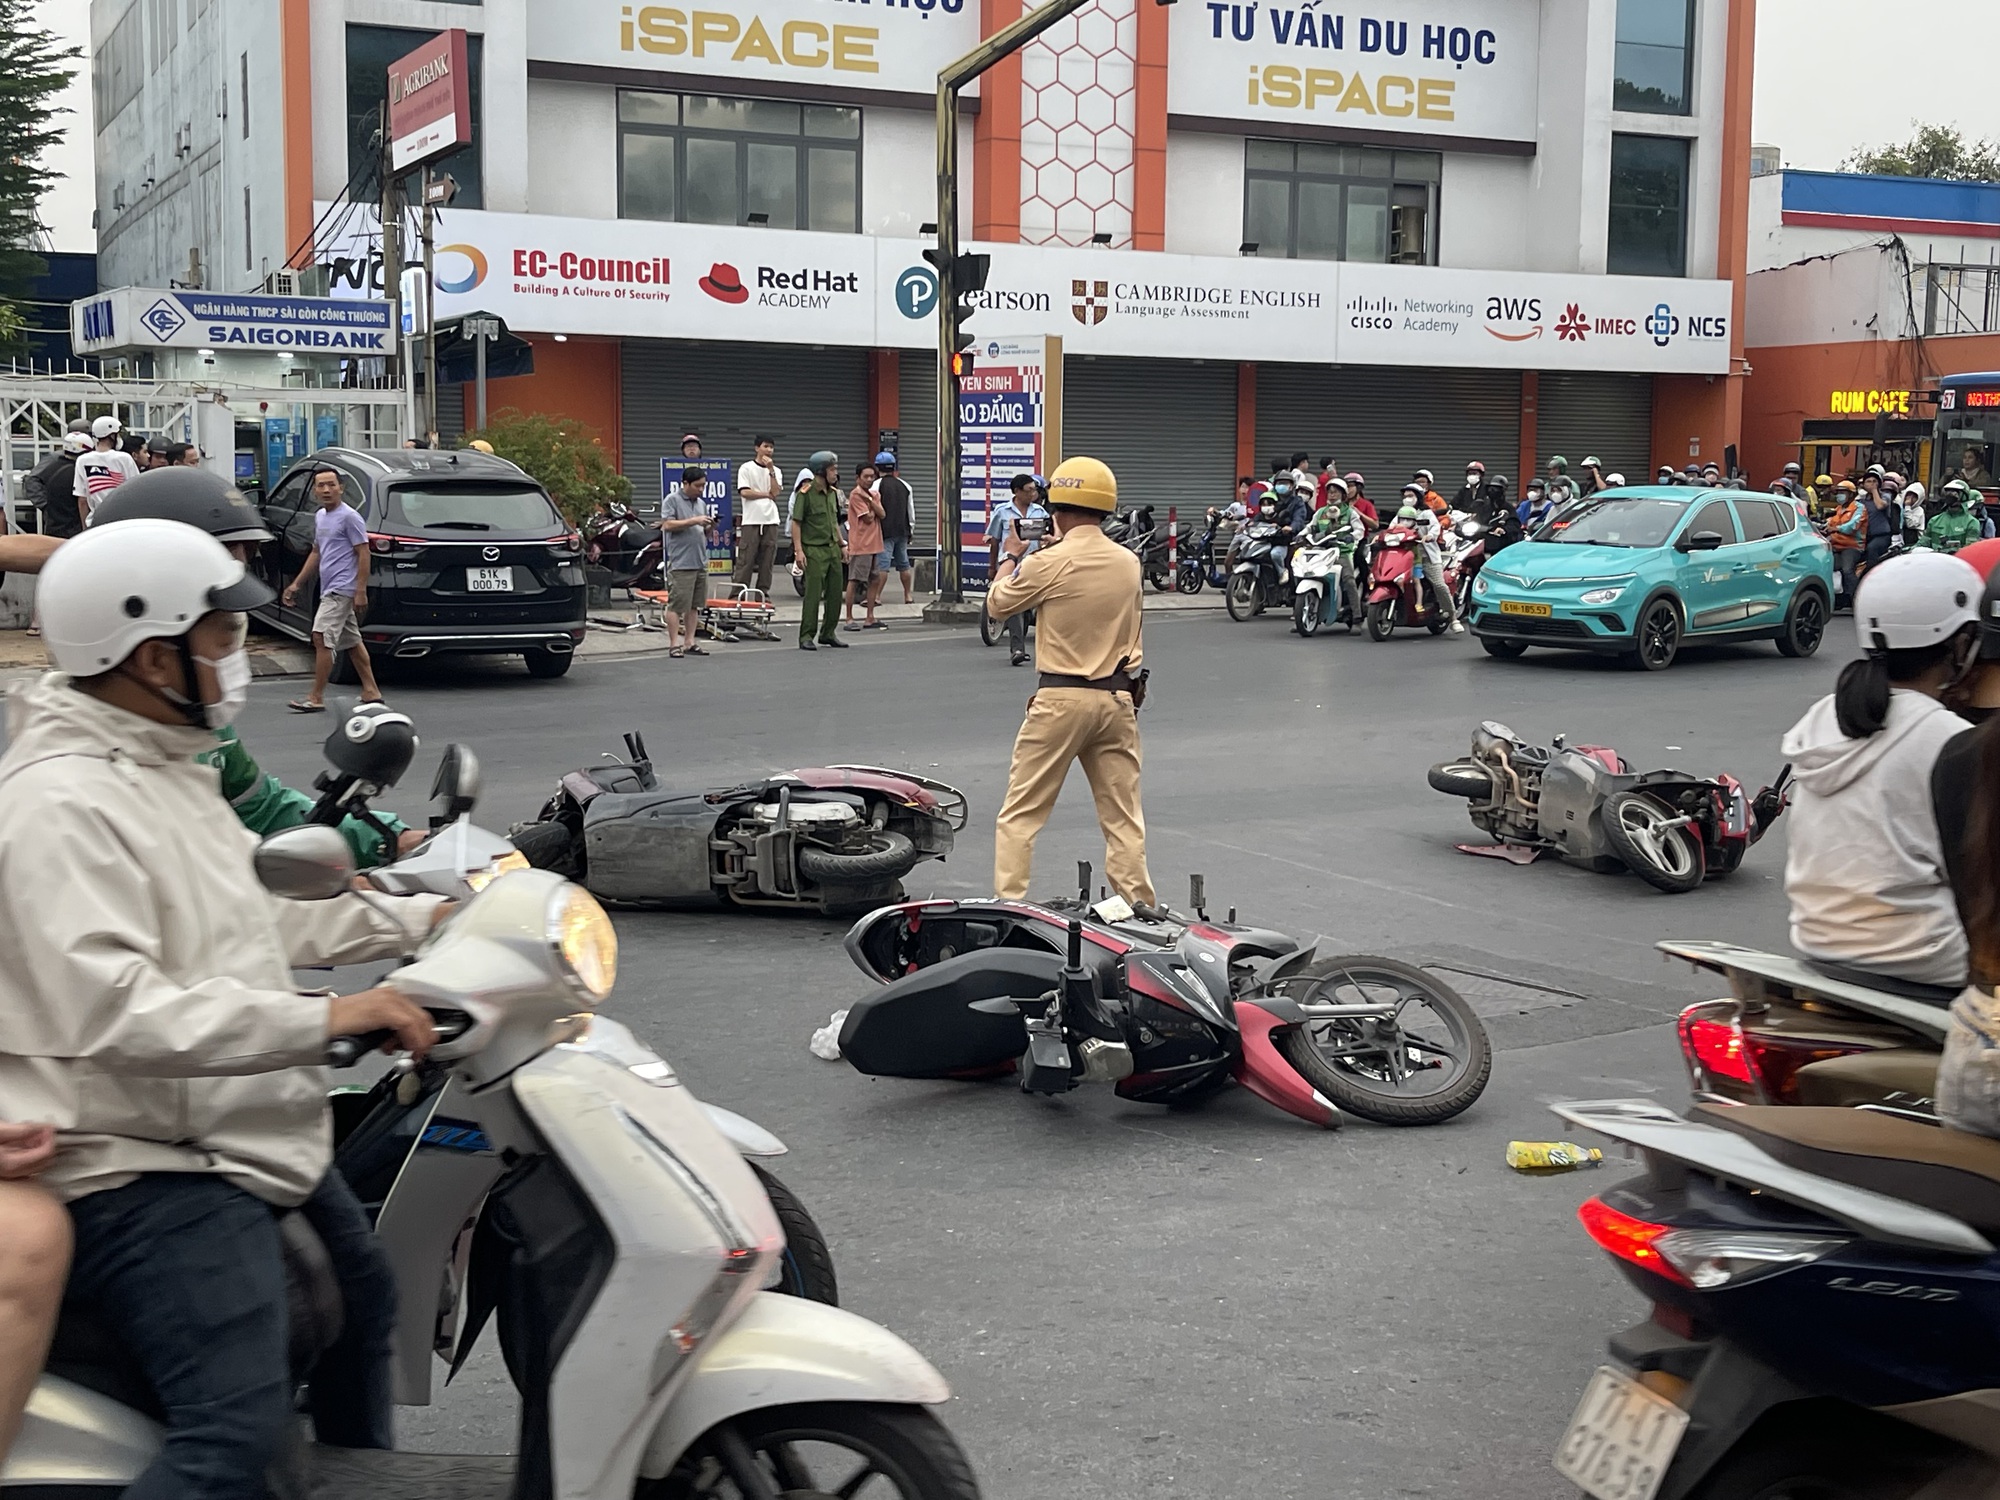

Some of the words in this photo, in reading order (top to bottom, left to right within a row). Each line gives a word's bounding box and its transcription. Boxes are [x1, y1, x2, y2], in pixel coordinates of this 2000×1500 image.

[620, 6, 880, 74] iSPACE
[1207, 2, 1258, 41] TƯ
[1269, 0, 1344, 50] VẤN
[1360, 17, 1408, 56] DU
[1422, 24, 1496, 70] HỌC
[403, 53, 449, 98] AGRIBANK
[1248, 64, 1456, 122] iSPACE
[513, 249, 671, 285] EC-Council
[757, 266, 807, 291] Red
[813, 269, 859, 294] Hat
[513, 283, 558, 297] Building
[562, 286, 570, 296] A
[573, 287, 611, 299] Culture
[615, 288, 627, 299] Of
[629, 290, 671, 303] Security
[758, 292, 831, 309] ACADEMY
[963, 289, 1050, 312] earson
[1115, 283, 1233, 305] CAMBRIDGE
[1240, 289, 1321, 308] ENGLISH
[193, 303, 221, 316] NGÂN
[223, 303, 250, 317] HÀNG
[252, 306, 278, 319] TMCP
[280, 305, 297, 319] SÀI
[298, 306, 319, 321] GÒN
[320, 307, 345, 322] CÔNG
[346, 310, 386, 323] THƯƠNG
[1115, 302, 1176, 319] Language
[1180, 304, 1250, 320] Assessment
[1404, 299, 1474, 317] Networking
[1486, 296, 1542, 322] aws
[1350, 316, 1393, 330] CISCO
[1403, 317, 1459, 335] Academy
[1595, 318, 1637, 336] IMEC
[1688, 316, 1726, 337] NCS
[208, 326, 385, 349] SAIGONBANK
[984, 375, 1013, 391] SINH
[979, 394, 1024, 423] ĐẲNG
[1831, 391, 1865, 413] RUM
[1867, 390, 1910, 413] CAFE
[1943, 393, 1955, 408] 57
[1052, 477, 1085, 489] CSGT
[479, 569, 499, 579] 61K
[472, 579, 508, 590] 000.79
